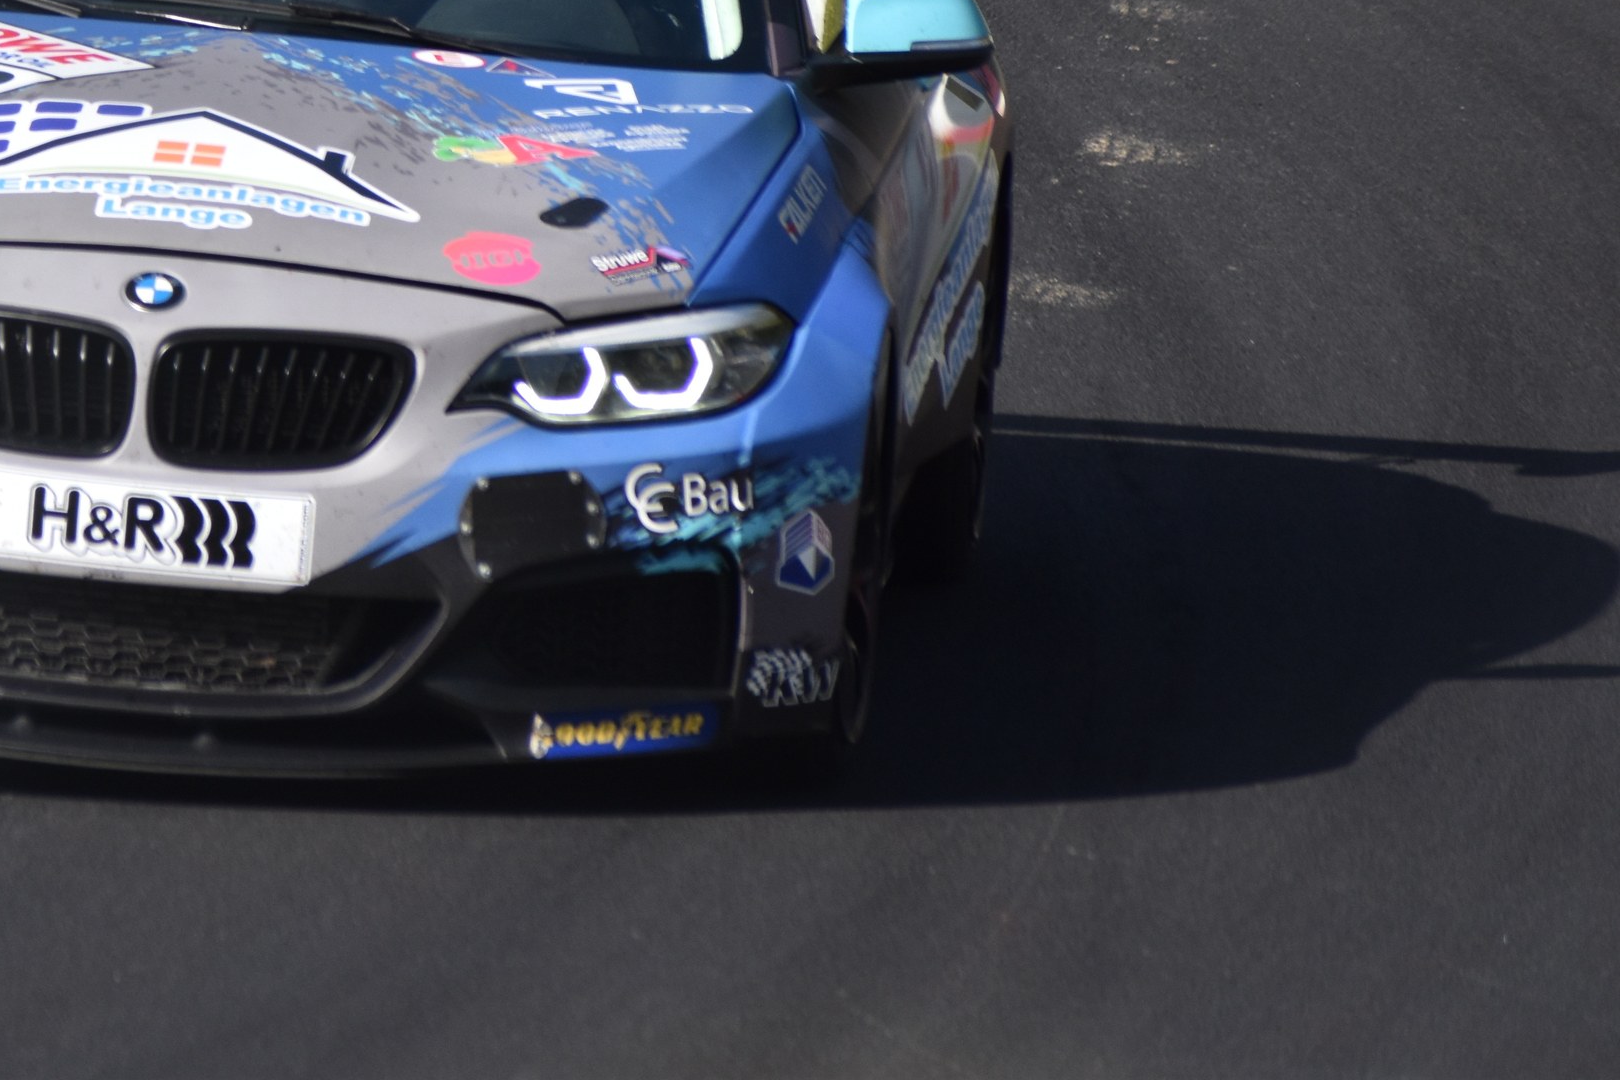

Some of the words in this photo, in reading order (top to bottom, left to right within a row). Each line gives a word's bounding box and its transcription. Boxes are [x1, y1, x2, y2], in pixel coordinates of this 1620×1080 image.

[102, 199, 248, 226] Lange
[590, 248, 649, 272] Struwe
[683, 473, 755, 517] Bau
[31, 484, 166, 554] H&R
